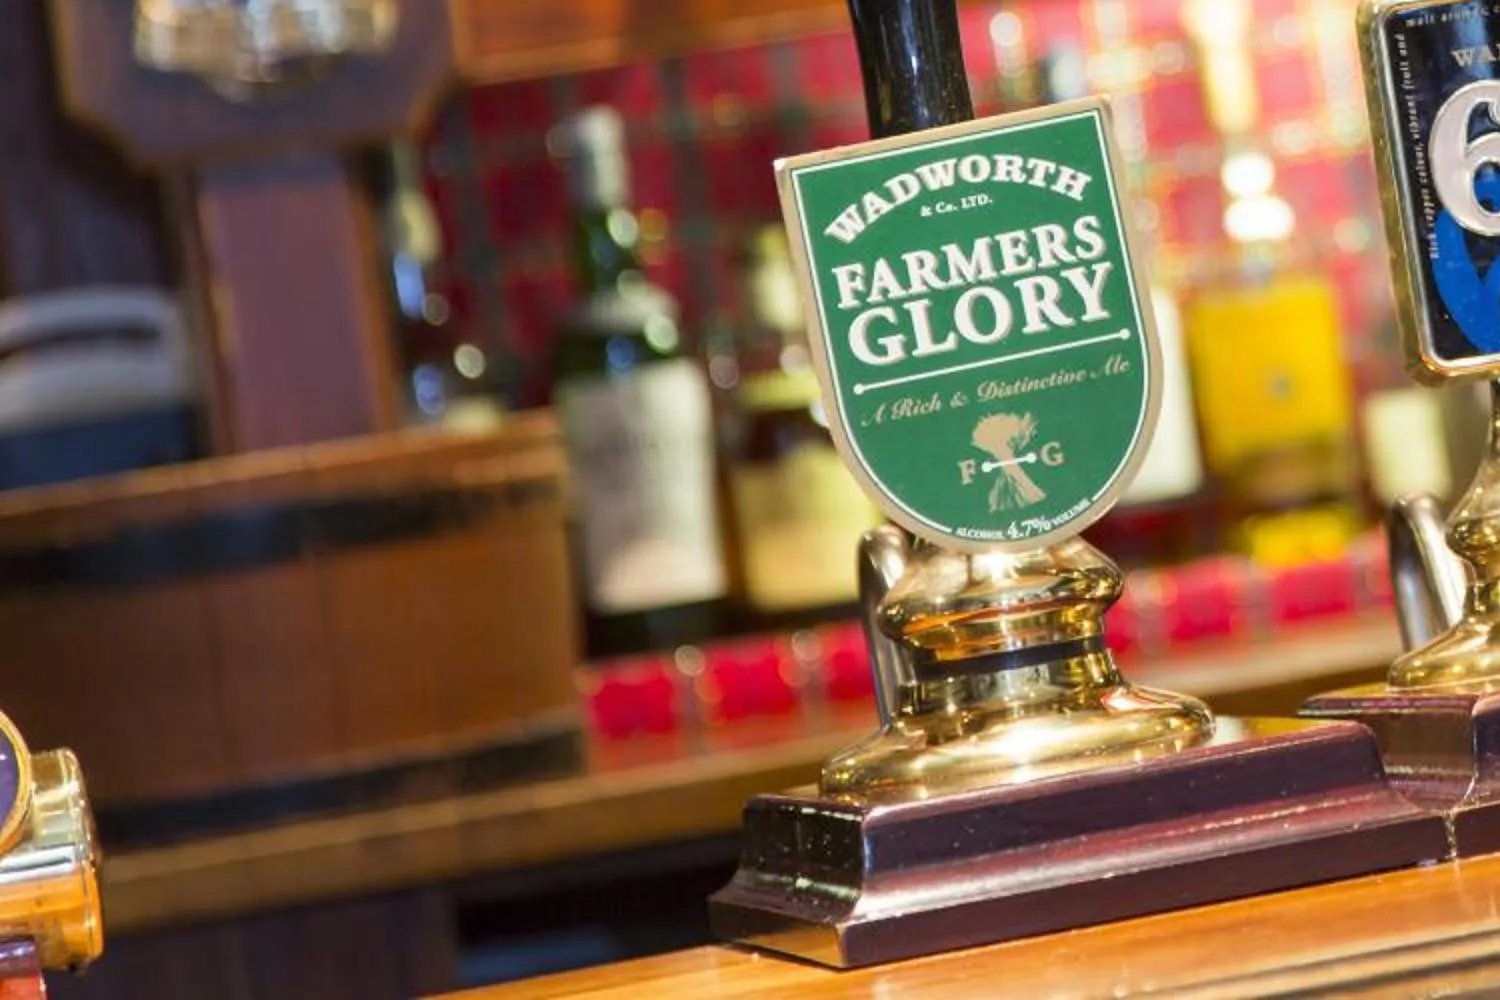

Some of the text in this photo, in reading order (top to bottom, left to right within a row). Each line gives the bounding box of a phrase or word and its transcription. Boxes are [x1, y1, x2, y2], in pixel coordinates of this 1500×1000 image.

[1394, 34, 1407, 56] and
[1400, 62, 1415, 89] fruit
[823, 153, 1093, 244] WADWORTH
[920, 206, 932, 217] &
[832, 216, 1106, 309] FARMERS
[848, 262, 1113, 366] GLORY
[891, 397, 942, 420] Rich
[950, 392, 968, 407] &
[976, 369, 1085, 403] Distinctive
[958, 442, 1064, 484] F G
[1006, 515, 1051, 540] 4.7%
